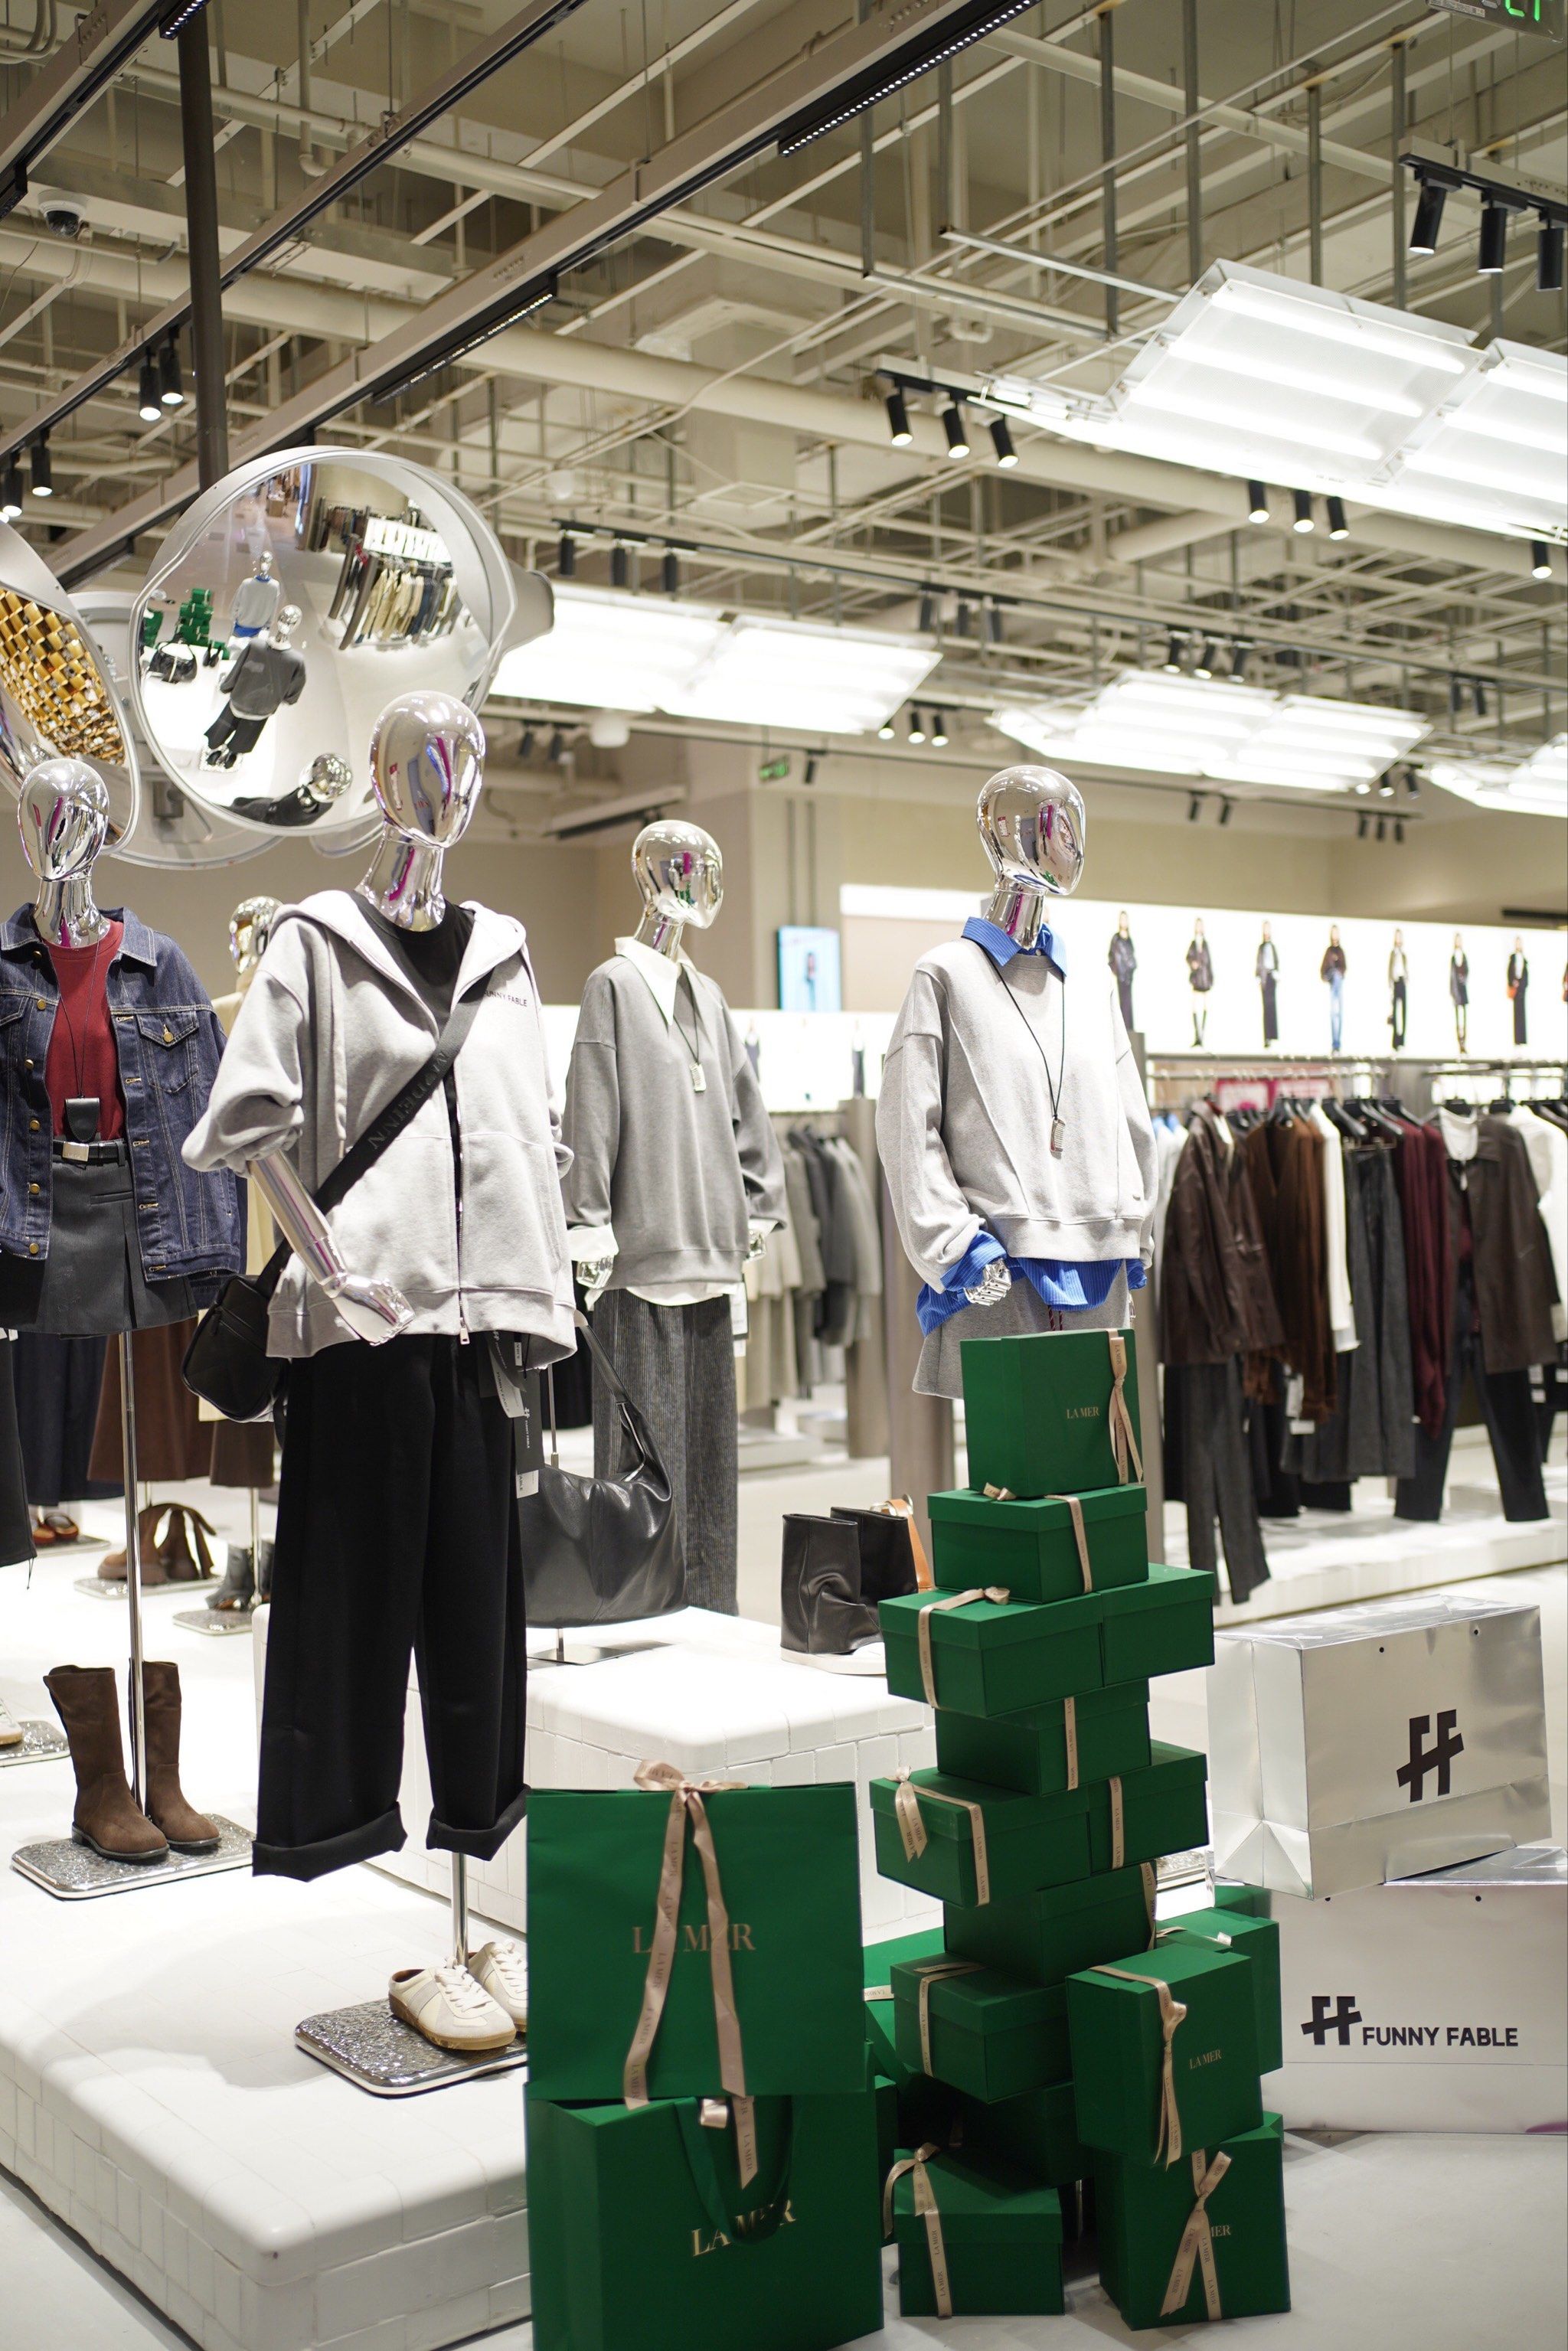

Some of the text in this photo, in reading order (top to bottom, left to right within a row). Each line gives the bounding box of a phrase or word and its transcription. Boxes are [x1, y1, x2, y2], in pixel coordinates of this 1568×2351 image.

[508, 994, 527, 1007] FABLE
[1067, 1406, 1100, 1419] LA MER
[682, 1923, 756, 1952] MR
[1363, 2027, 1439, 2046] FUNNY
[1447, 2027, 1518, 2046] FABLE
[1189, 2049, 1222, 2069] LA MER
[744, 2148, 754, 2170] MER
[692, 2228, 732, 2258] LA
